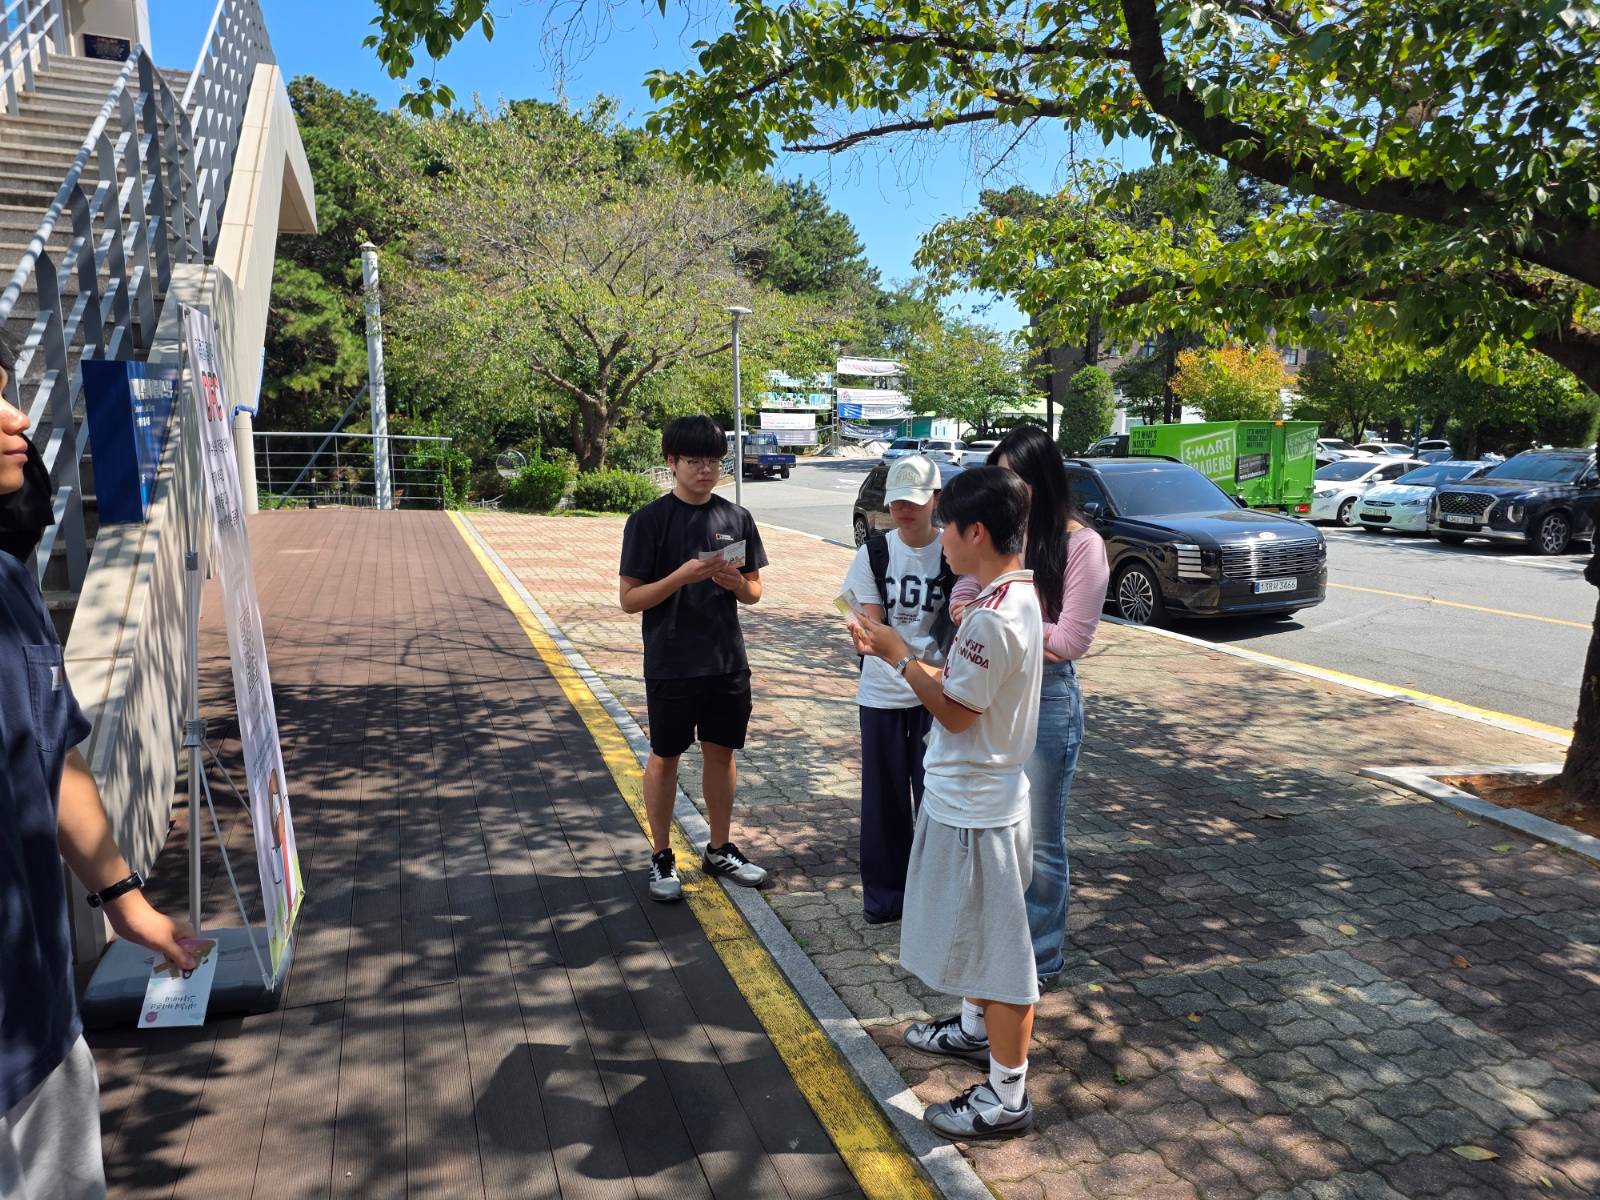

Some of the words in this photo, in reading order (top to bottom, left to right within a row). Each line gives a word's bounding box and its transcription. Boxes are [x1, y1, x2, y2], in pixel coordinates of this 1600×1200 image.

[1132, 431, 1141, 440] IT'S
[1141, 430, 1157, 439] WHAT'S
[1132, 440, 1146, 449] INSIDE
[1146, 439, 1157, 448] THAT
[1189, 455, 1232, 475] RADERS
[965, 639, 985, 654] VSIT
